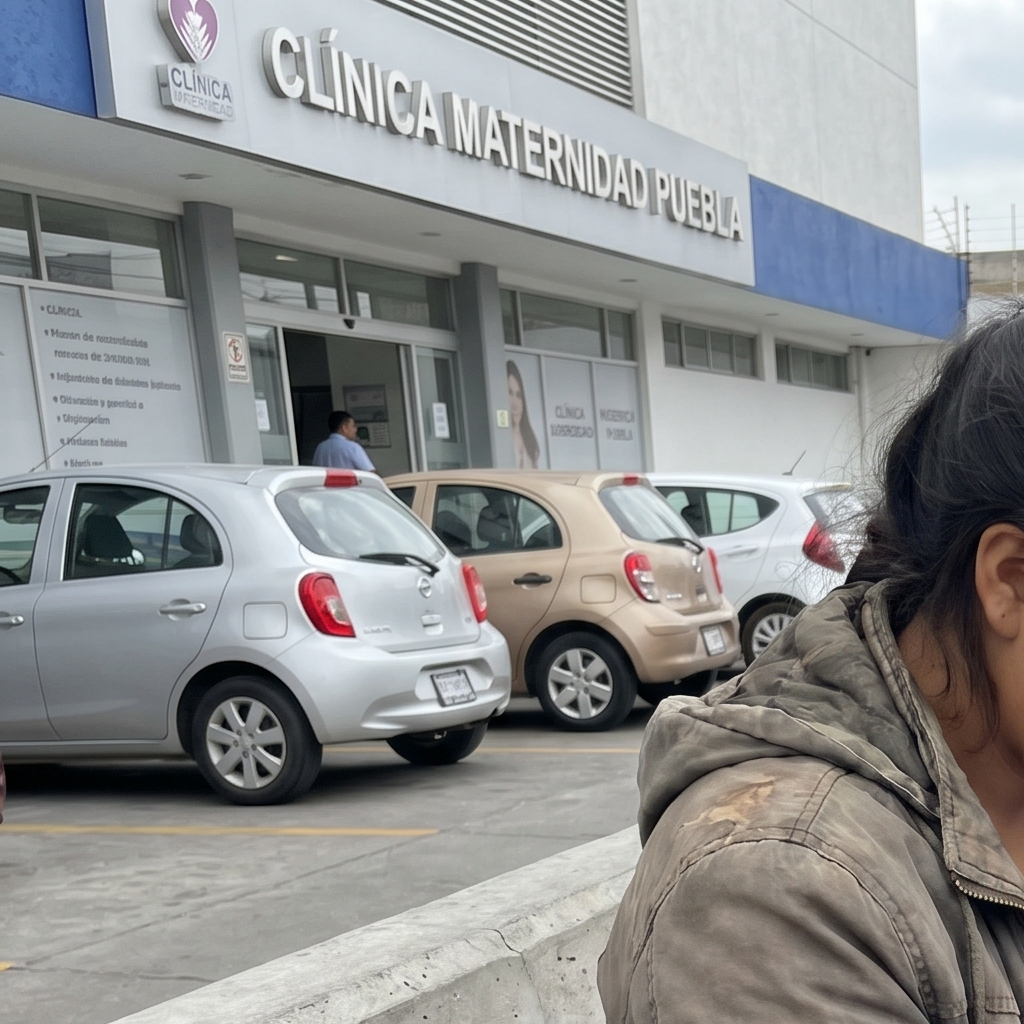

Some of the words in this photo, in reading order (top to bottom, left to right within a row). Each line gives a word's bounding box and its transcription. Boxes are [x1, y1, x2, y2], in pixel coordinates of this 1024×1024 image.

[170, 67, 232, 103] CLÍNICA
[262, 27, 444, 146] CLÍNICA
[442, 92, 649, 209] MATERNIDAD
[647, 167, 745, 241] PUEBLA
